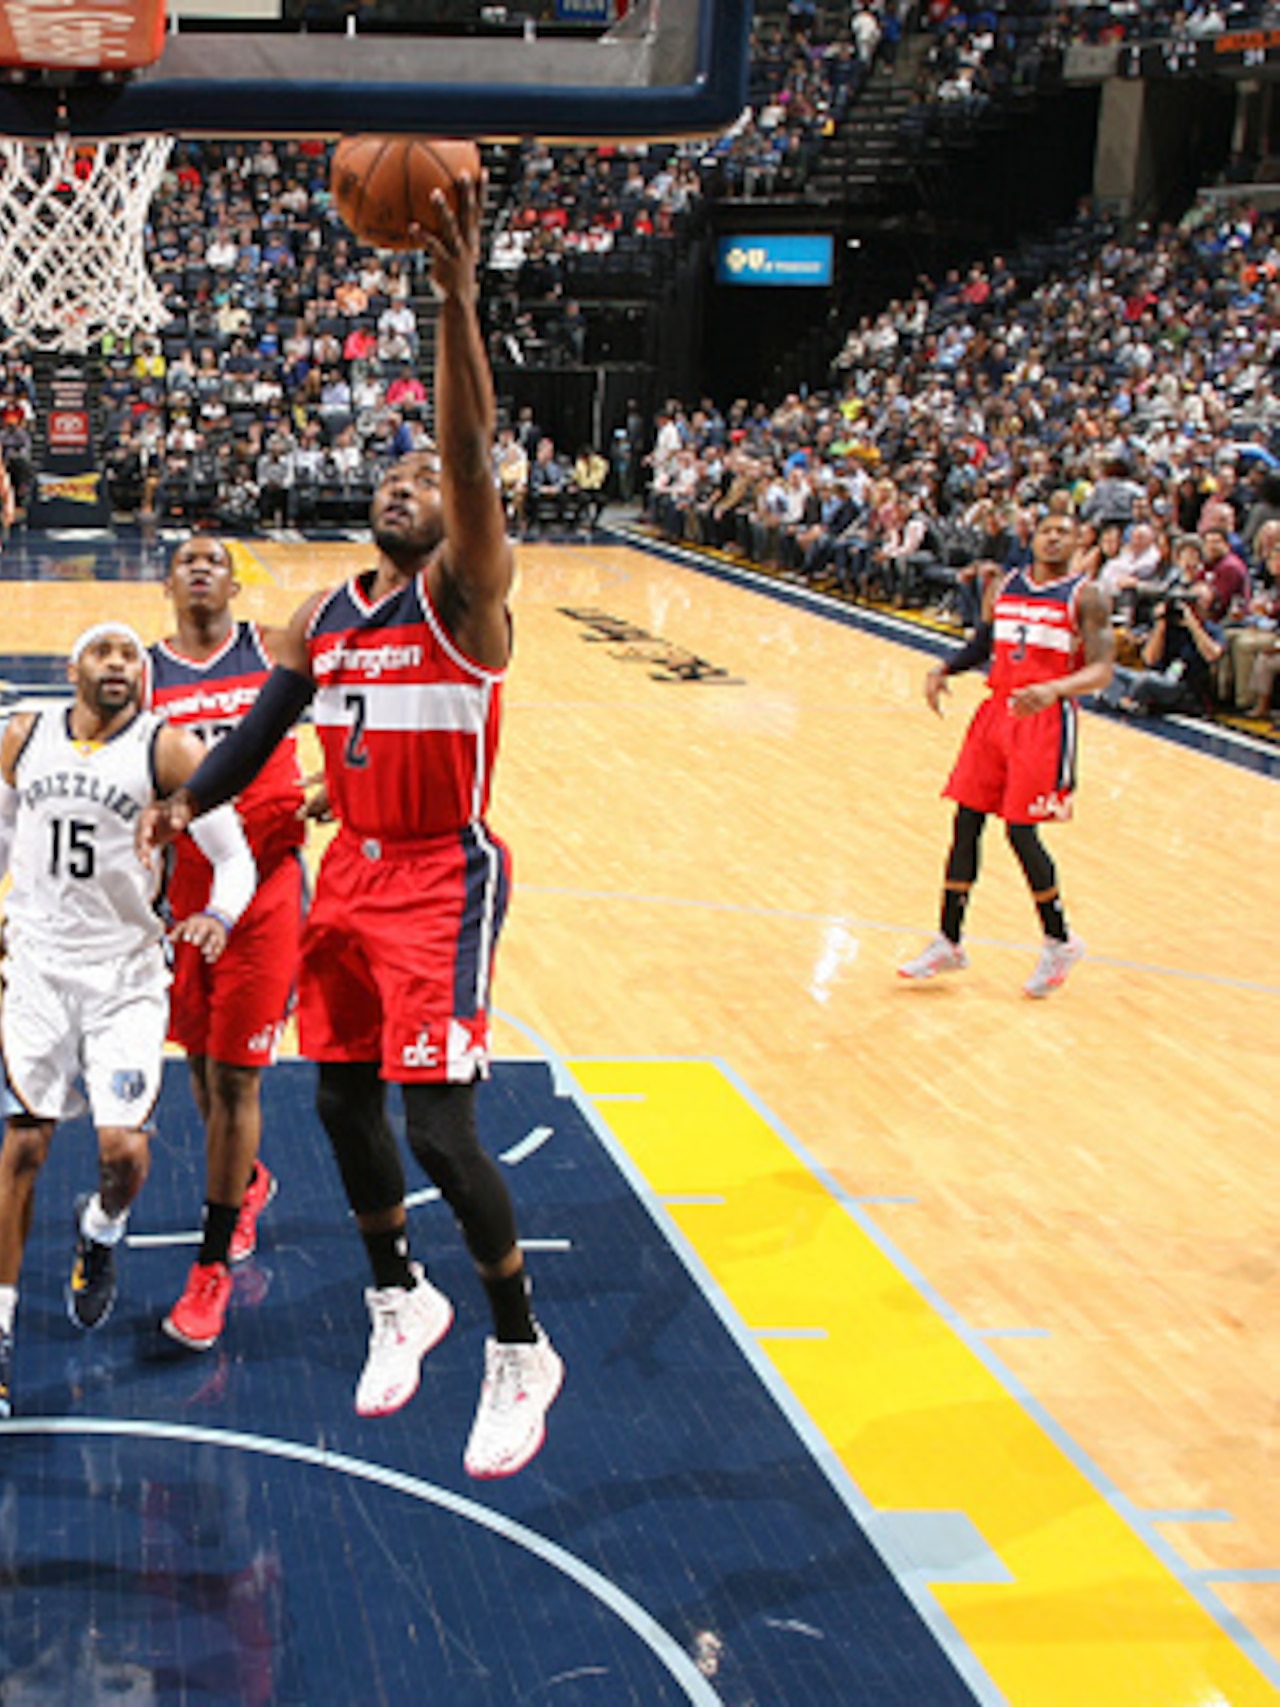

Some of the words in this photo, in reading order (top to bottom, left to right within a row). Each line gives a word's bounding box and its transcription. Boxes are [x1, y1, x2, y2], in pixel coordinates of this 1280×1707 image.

[312, 637, 422, 679] ashington
[344, 693, 369, 767] 2
[50, 818, 96, 880] 15
